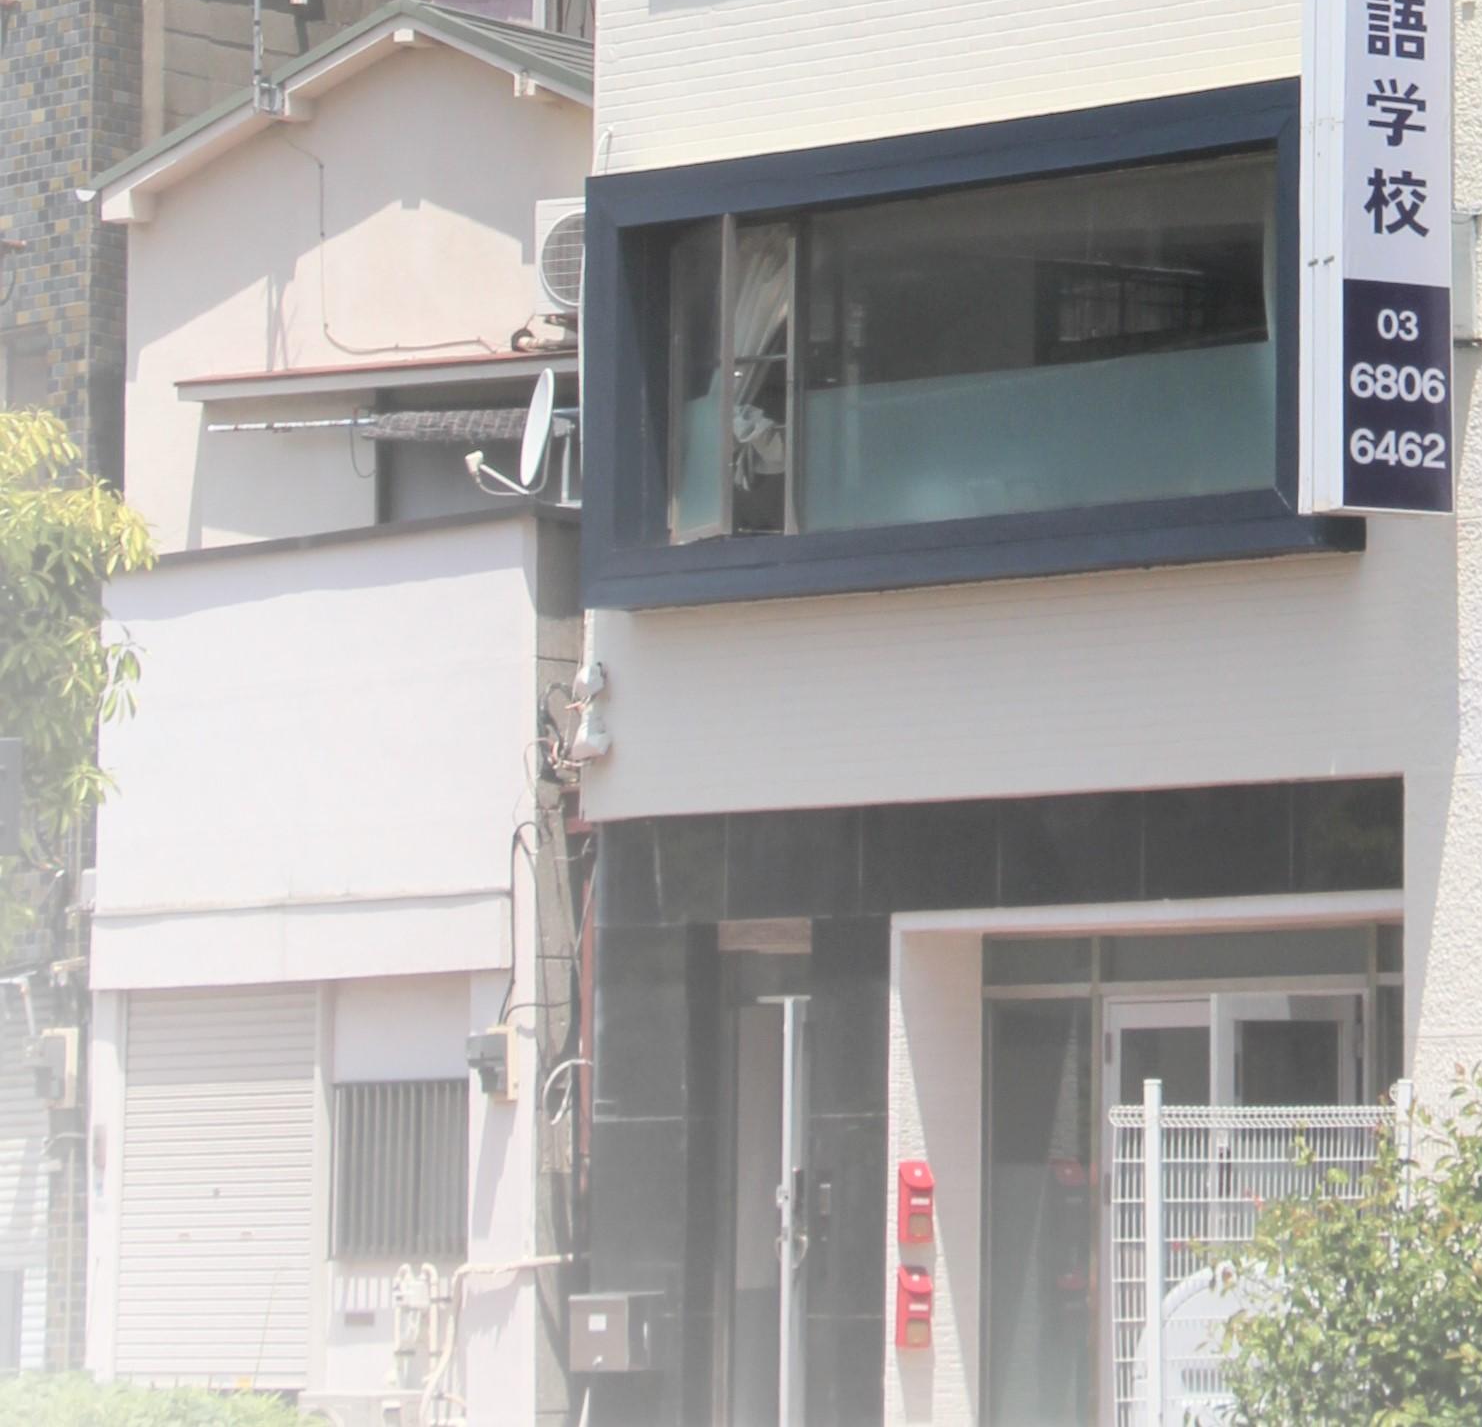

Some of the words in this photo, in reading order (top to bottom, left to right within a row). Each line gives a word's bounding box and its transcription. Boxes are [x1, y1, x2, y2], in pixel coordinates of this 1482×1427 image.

[1377, 308, 1419, 341] 03
[1350, 362, 1446, 404] 6806
[1350, 428, 1446, 470] 6462
